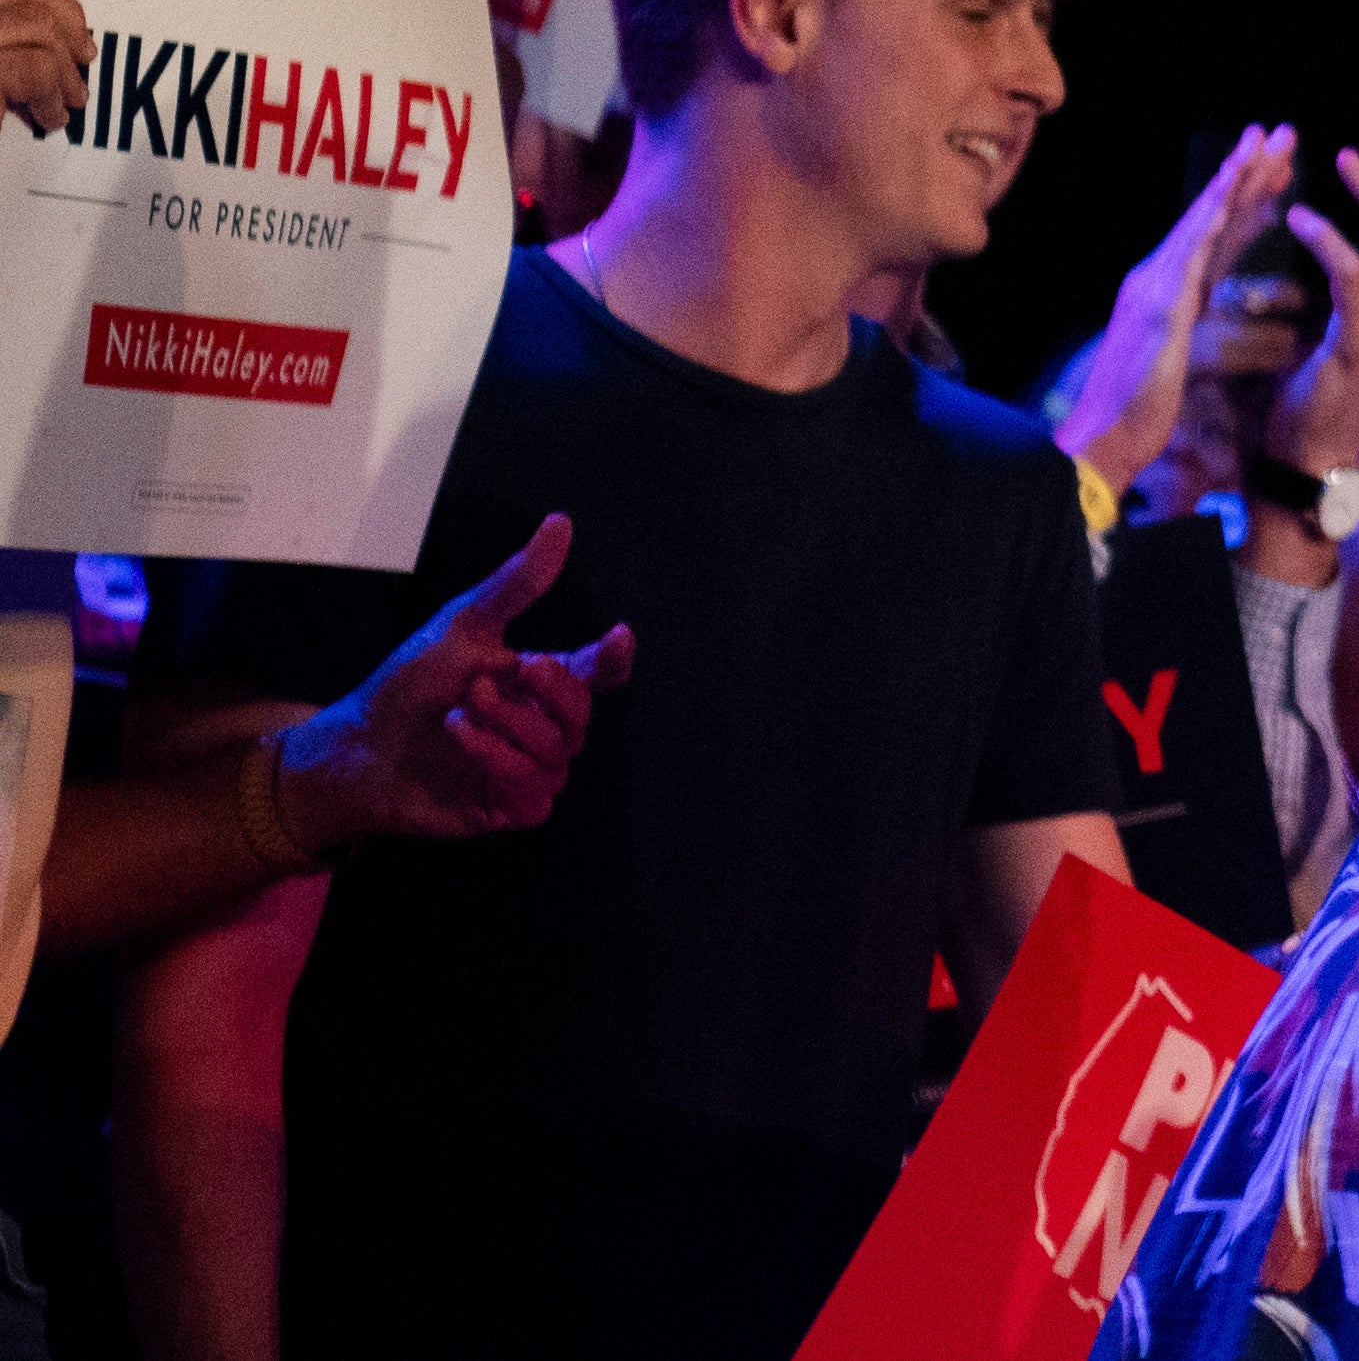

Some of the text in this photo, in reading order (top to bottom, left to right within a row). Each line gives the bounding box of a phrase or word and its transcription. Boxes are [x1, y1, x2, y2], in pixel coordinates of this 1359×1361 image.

[148, 192, 352, 252] FOR PRESIDENT
[104, 320, 333, 395] NikkiHaley.com
